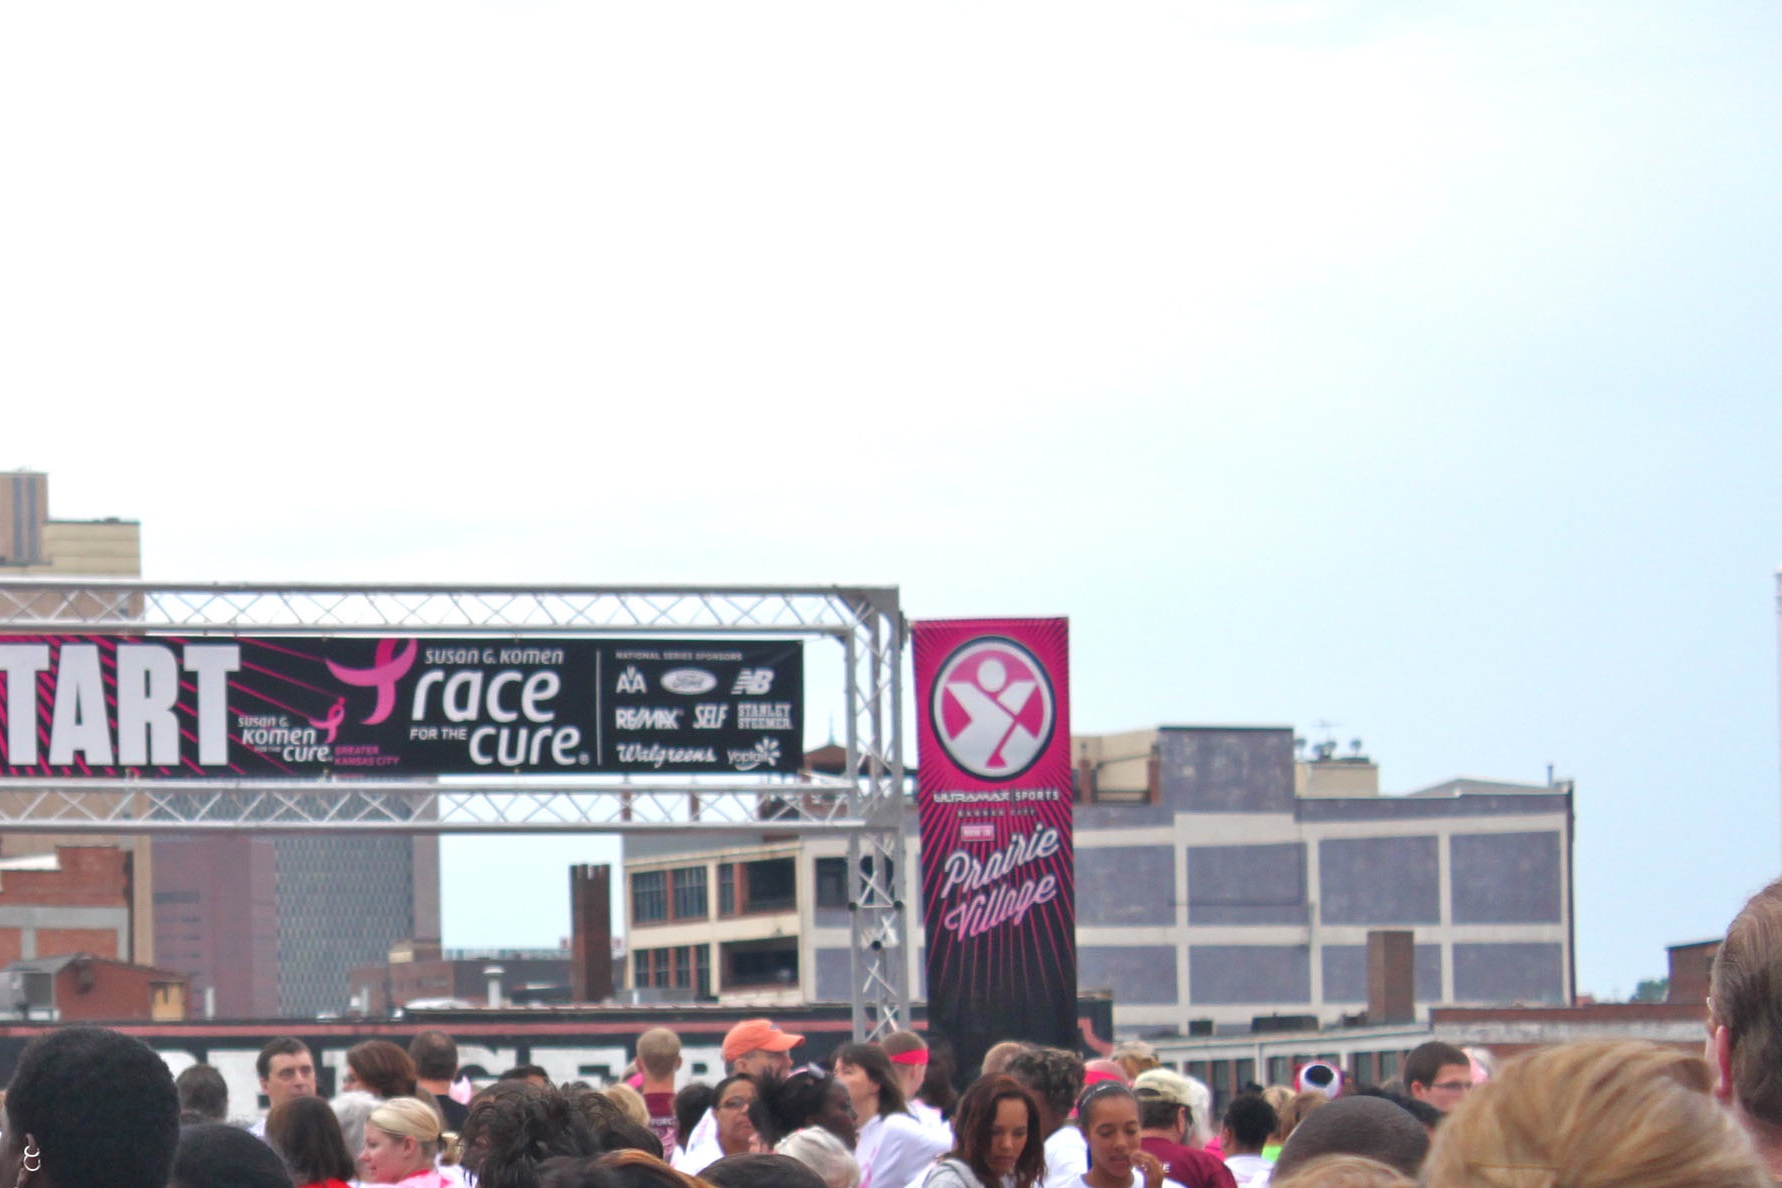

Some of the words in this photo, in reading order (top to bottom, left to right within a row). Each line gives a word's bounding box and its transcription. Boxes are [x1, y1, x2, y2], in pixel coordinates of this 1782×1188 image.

[616, 651, 661, 661] NATIONAL
[663, 651, 693, 661] SERIES
[695, 652, 743, 661] SPONSORS
[411, 669, 561, 723] race
[692, 703, 730, 729] SELF
[737, 702, 792, 717] STANLEY
[410, 728, 438, 740] FOR
[441, 728, 467, 740] THE
[616, 743, 718, 769] Walgreens
[1014, 790, 1060, 801] SPORTS
[940, 823, 1060, 899] Prairie
[944, 874, 1058, 943] Village
